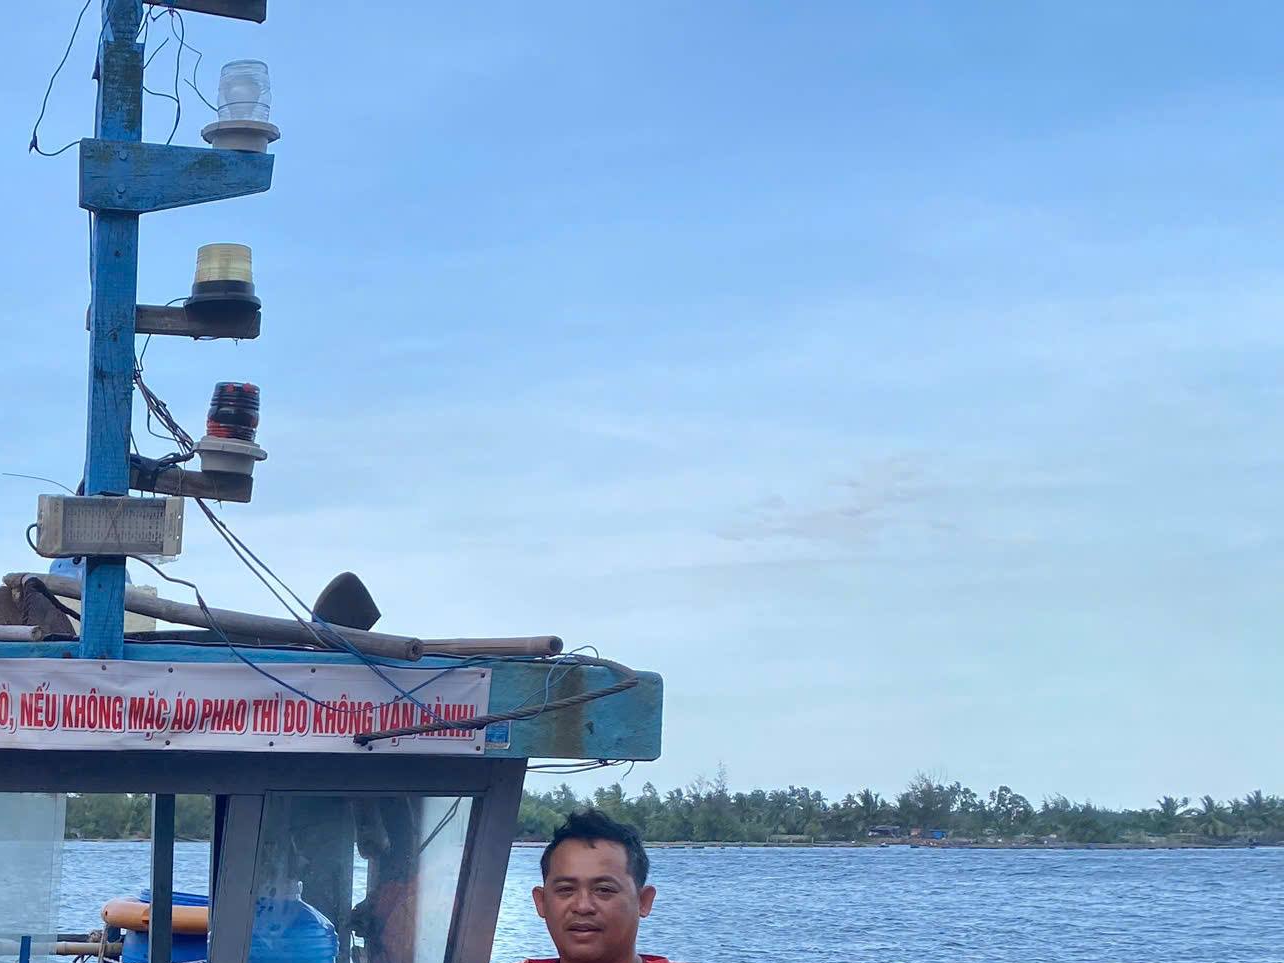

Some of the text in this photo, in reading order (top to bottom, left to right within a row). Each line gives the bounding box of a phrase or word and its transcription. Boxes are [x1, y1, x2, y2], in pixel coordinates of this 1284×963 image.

[20, 682, 58, 728] NẾU
[62, 688, 124, 730] KHÔNG
[128, 690, 169, 738] MẶC
[170, 691, 197, 731] ÁO
[198, 698, 247, 732] PHAO
[252, 692, 280, 733] THÌ
[312, 693, 373, 735] KHÔNG
